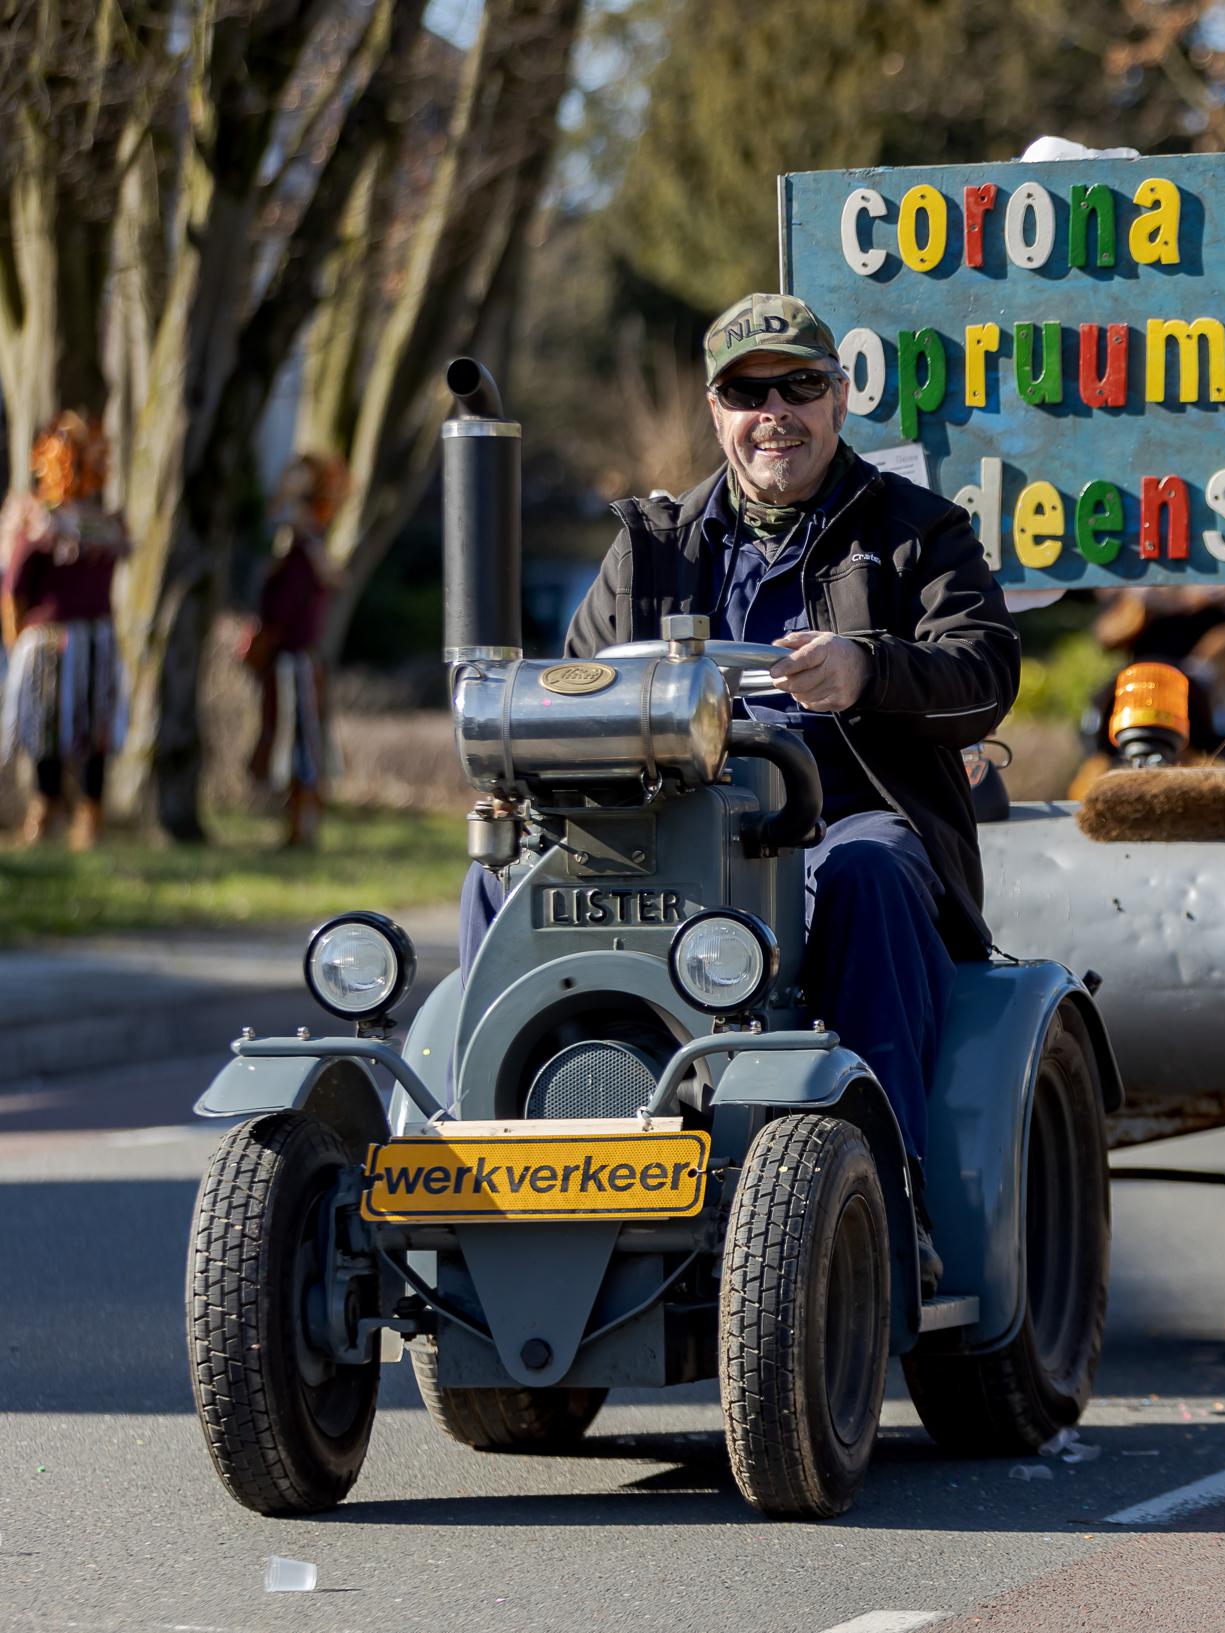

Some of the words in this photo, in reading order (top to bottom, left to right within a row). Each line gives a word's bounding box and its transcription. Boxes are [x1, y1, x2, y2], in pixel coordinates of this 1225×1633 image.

[840, 177, 1182, 276] corona
[726, 315, 790, 349] NLD
[550, 889, 682, 925] LISTER
[383, 1155, 691, 1195] werkverkeer
